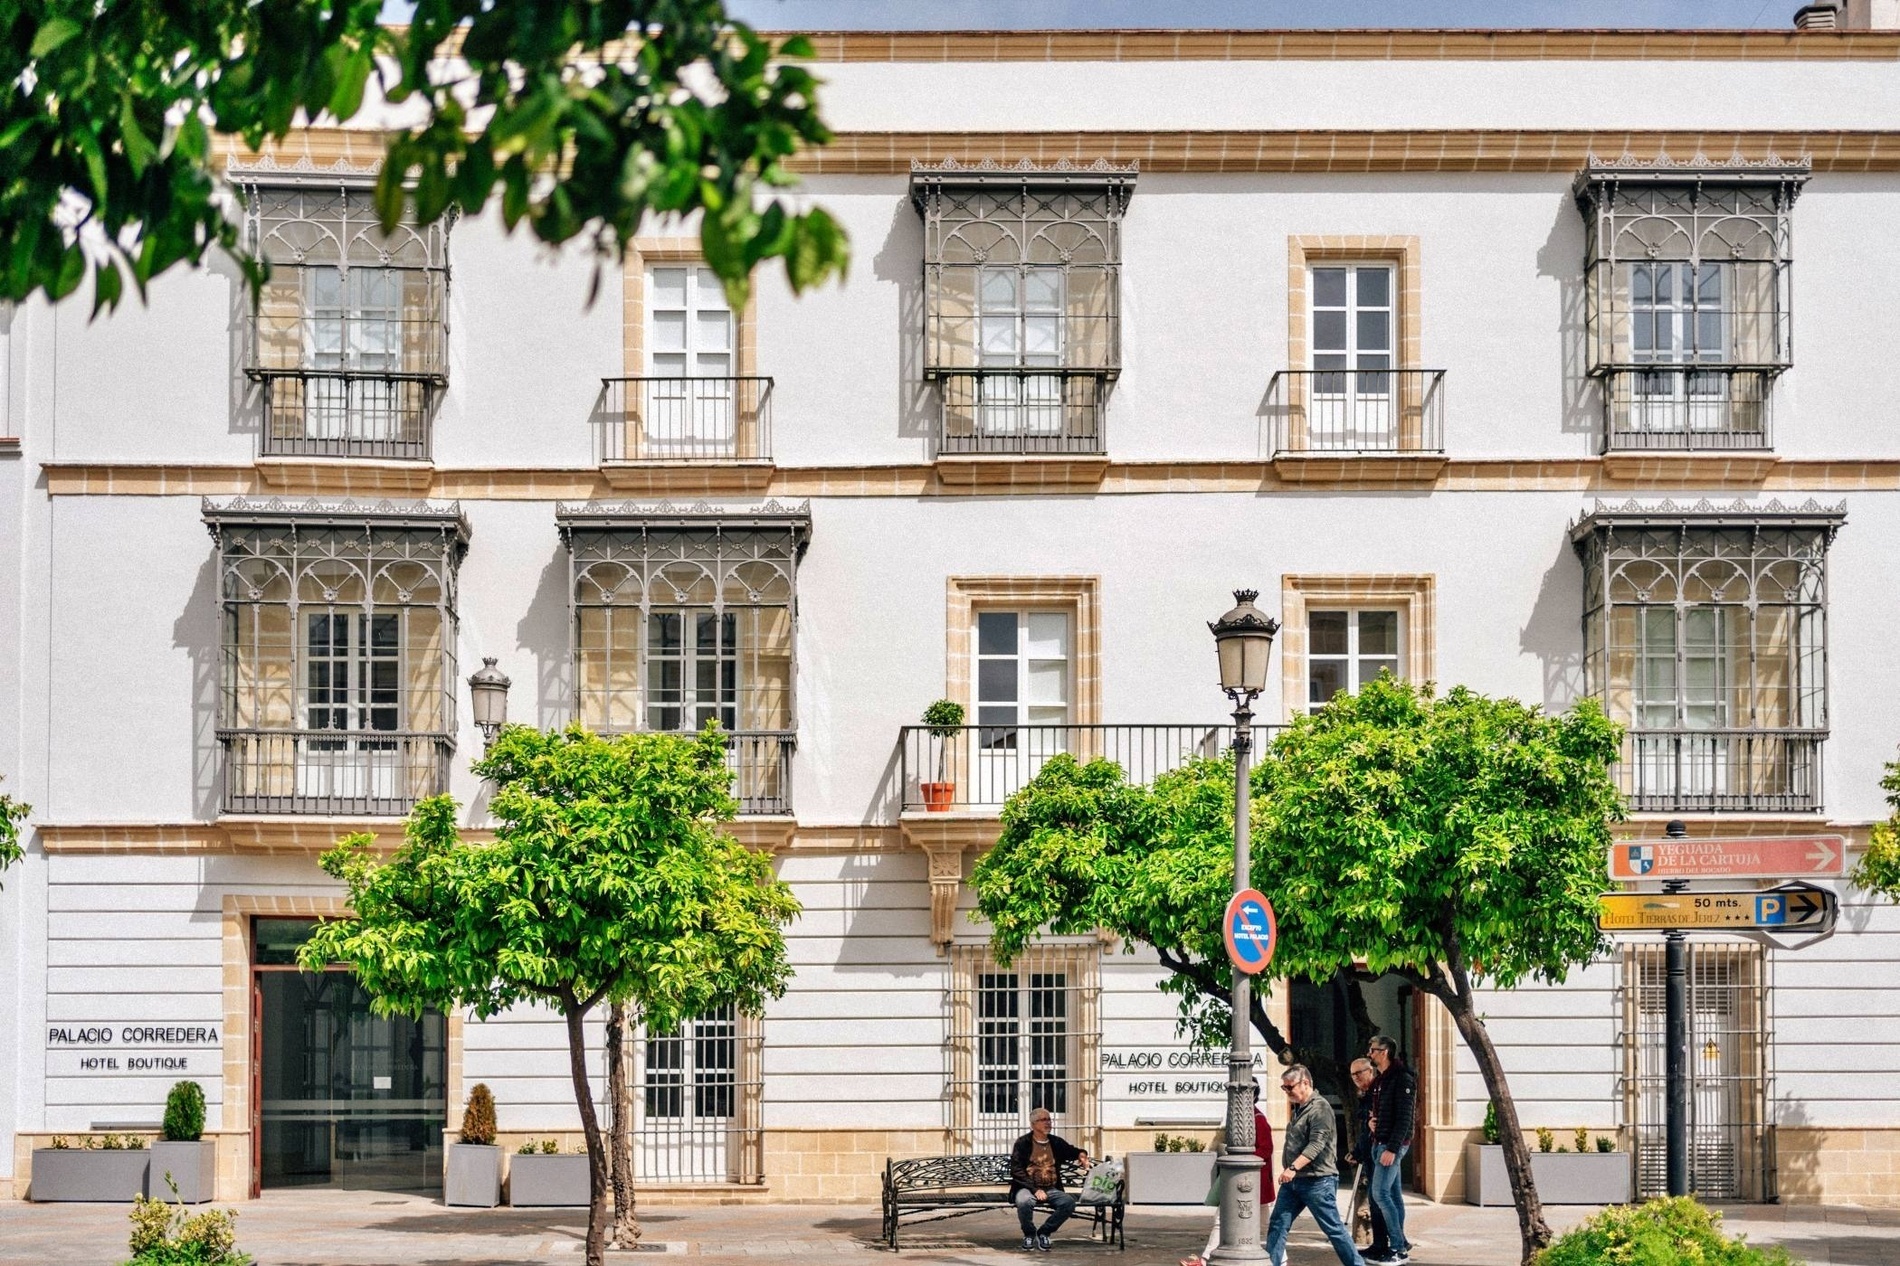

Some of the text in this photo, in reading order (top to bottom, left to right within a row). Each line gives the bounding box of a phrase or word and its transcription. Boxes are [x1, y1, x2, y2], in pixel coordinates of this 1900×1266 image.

[1658, 844, 1723, 855] YEGUADA
[1657, 854, 1761, 866] DE LA CARTUJA
[1694, 897, 1742, 908] 50 mts.
[50, 1028, 218, 1042] PALACIO CORREDERA
[81, 1058, 188, 1069] HOTEL BOUTIQUE
[1101, 1053, 1163, 1067] PALACIO
[1129, 1082, 1168, 1093] HOTEL
